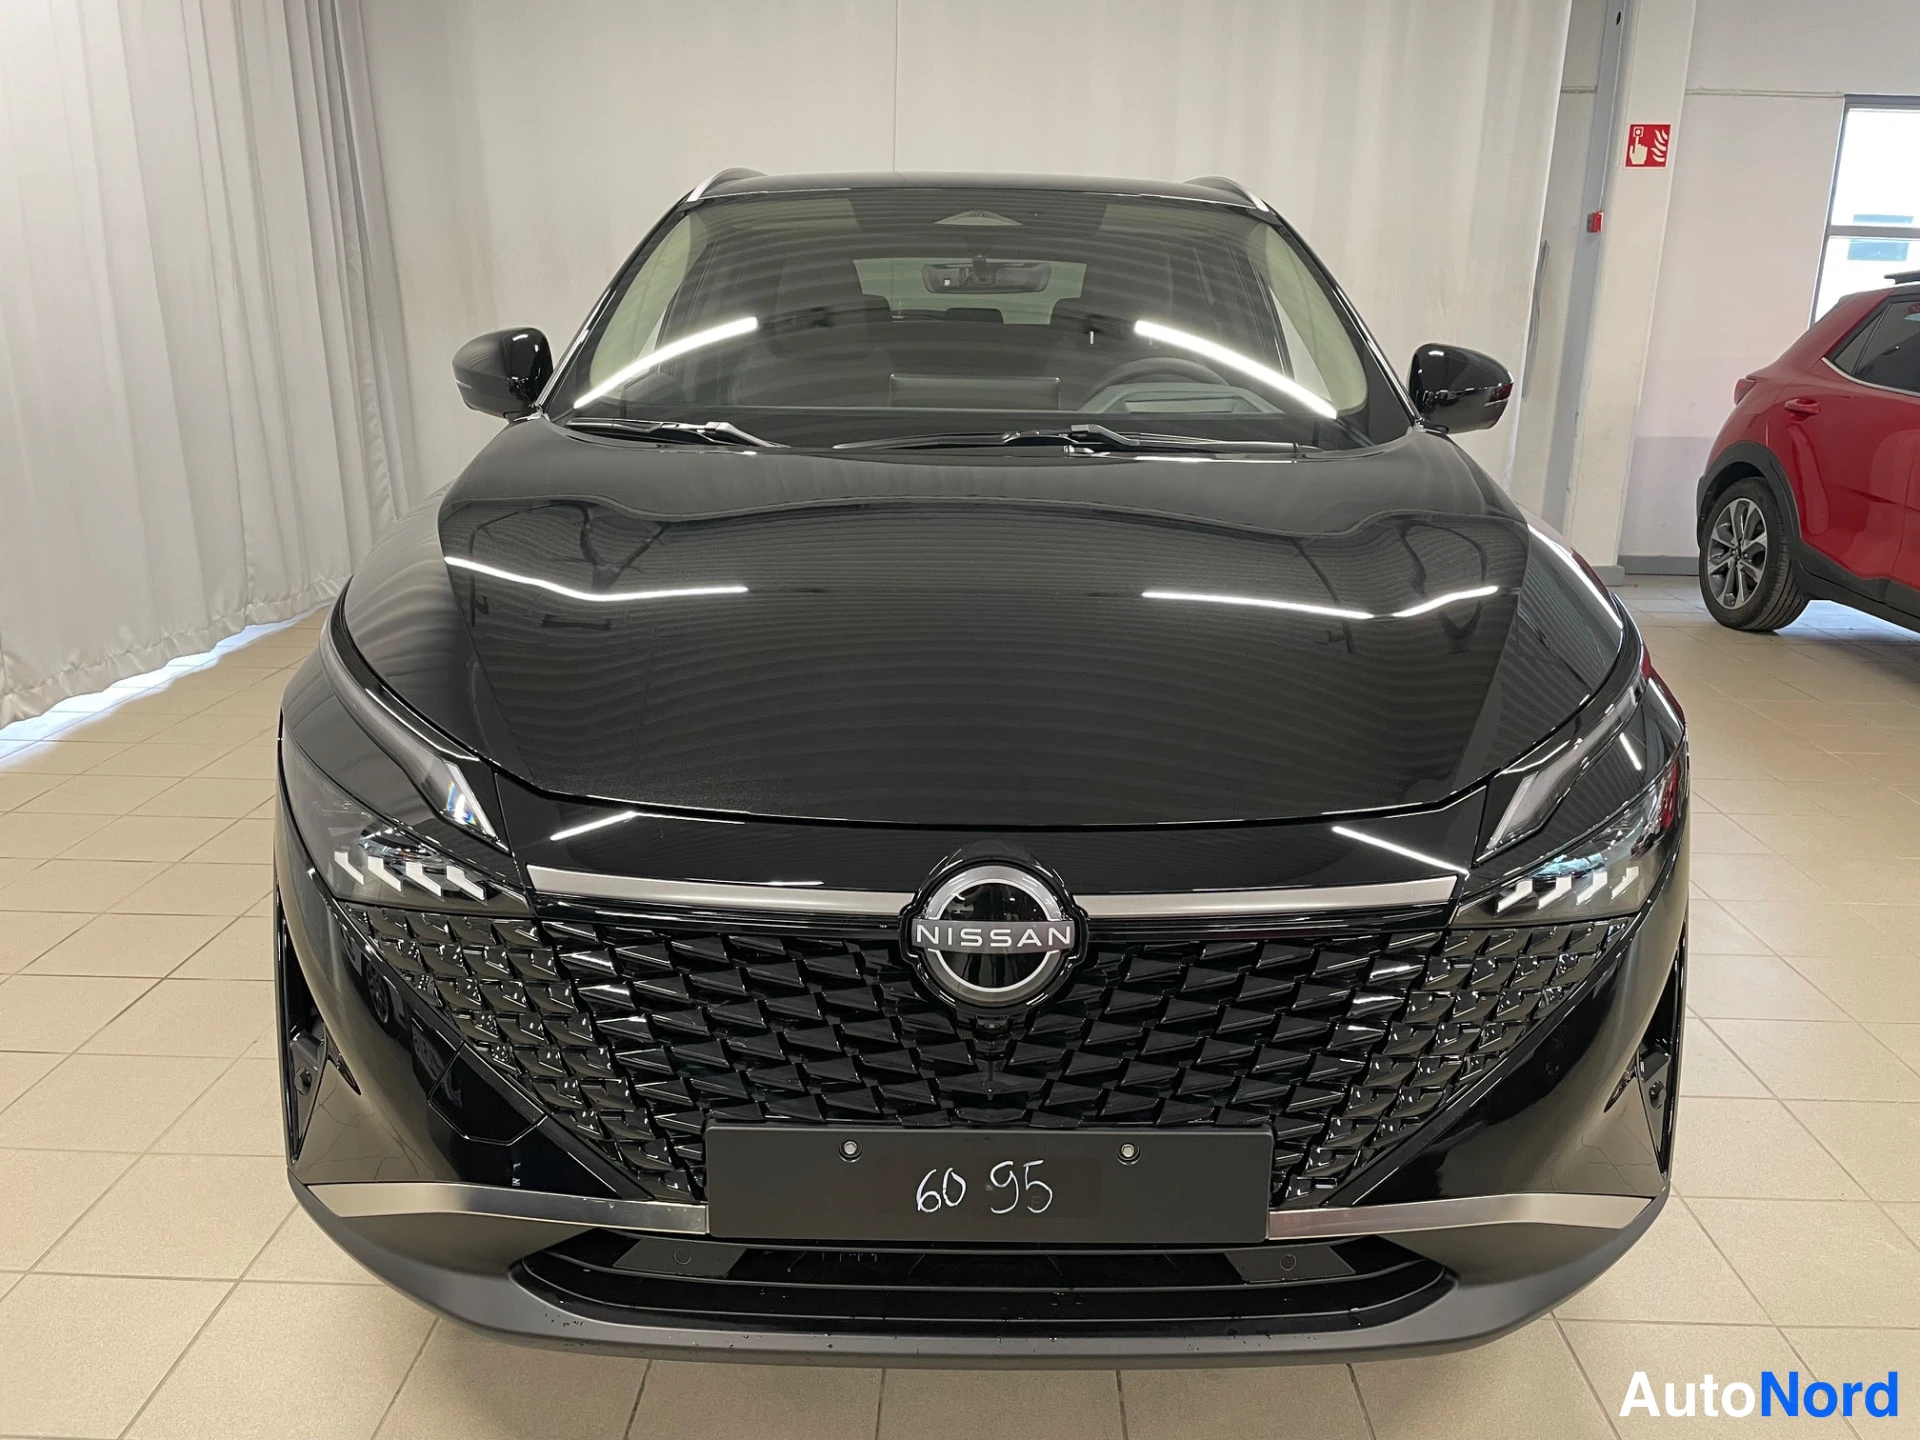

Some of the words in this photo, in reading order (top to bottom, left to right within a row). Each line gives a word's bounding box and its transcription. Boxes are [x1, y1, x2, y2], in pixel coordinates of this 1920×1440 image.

[916, 924, 1071, 948] NISSAN
[916, 1167, 967, 1213] 60
[989, 1160, 1053, 1214] 95
